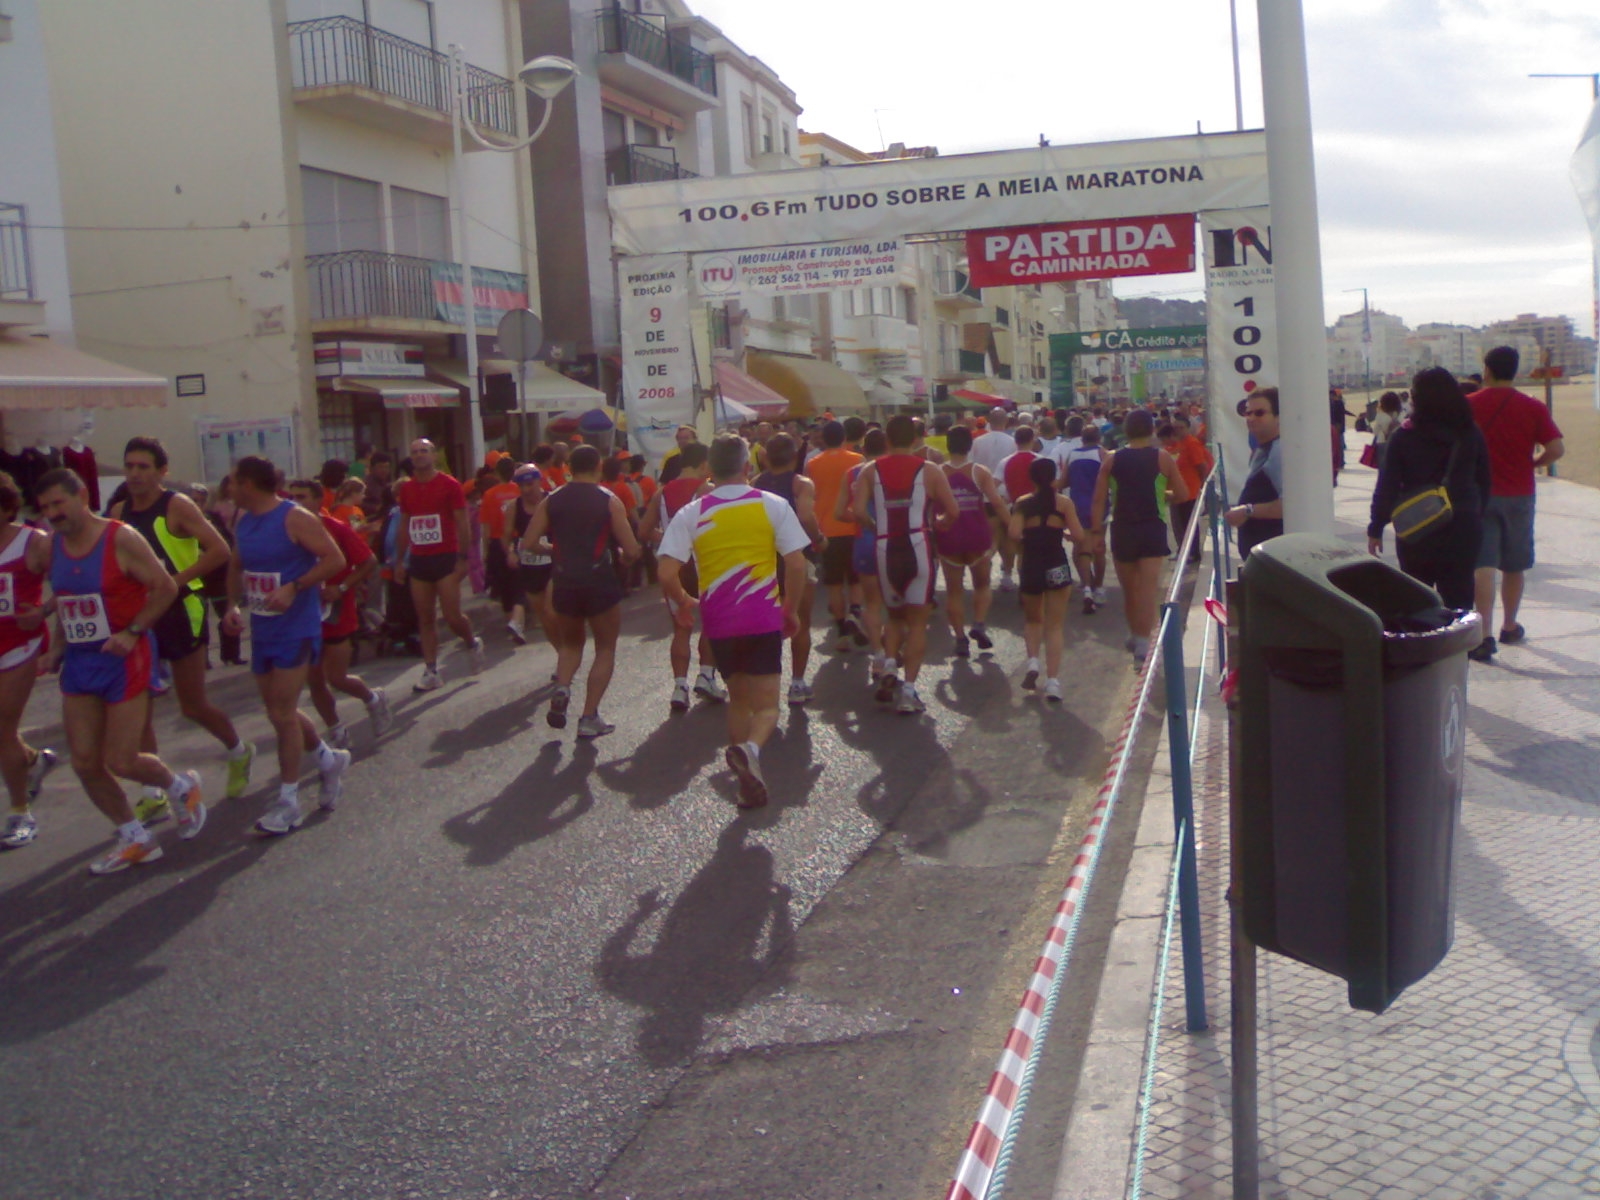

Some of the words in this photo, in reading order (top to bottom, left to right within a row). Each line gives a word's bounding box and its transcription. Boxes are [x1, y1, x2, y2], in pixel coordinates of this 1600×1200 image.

[677, 201, 770, 223] 100.6
[774, 200, 808, 216] Fm
[814, 191, 879, 212] TUDO
[886, 184, 966, 206] SOBRE
[974, 182, 991, 198] A
[999, 176, 1058, 197] MEIA
[1066, 165, 1205, 191] MARATONA
[985, 223, 1176, 262] PARTIDA
[810, 248, 817, 258] E
[865, 254, 895, 264] Venda
[1010, 252, 1150, 277] CAMINHADA
[702, 267, 734, 283] ITU
[758, 275, 777, 286] 262
[781, 273, 800, 283] 562
[804, 271, 819, 281] 114
[832, 269, 849, 279] 917
[853, 266, 872, 277] 225
[876, 264, 895, 275] 614
[633, 284, 672, 297] EDIÇÃO
[650, 307, 662, 323] 9
[645, 330, 665, 342] DE
[1105, 331, 1133, 349] CA
[634, 346, 679, 356] NOVEMBRO
[647, 364, 667, 377] DE
[638, 387, 675, 399] 2008
[412, 518, 437, 530] ITU
[67, 622, 97, 639] 189
